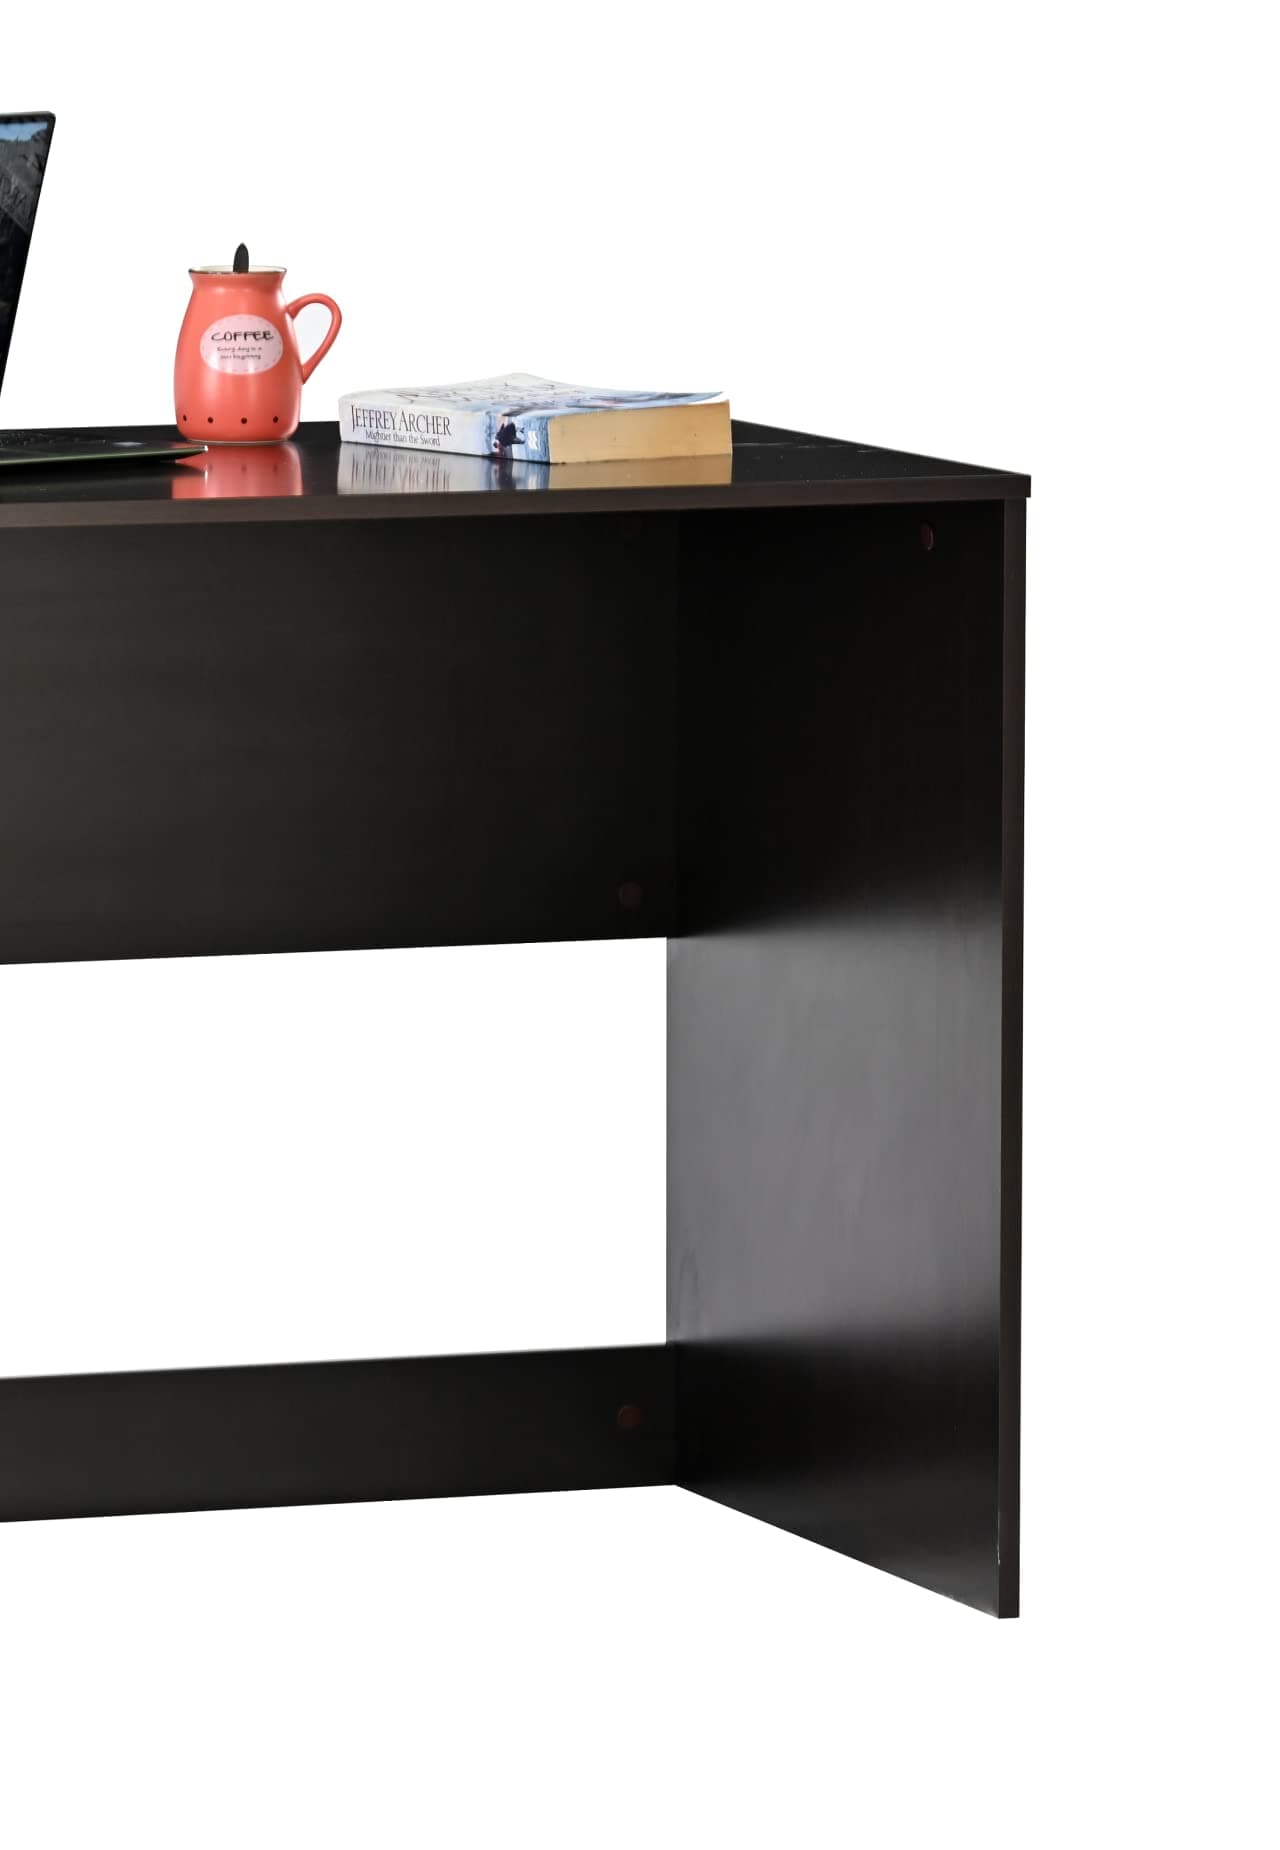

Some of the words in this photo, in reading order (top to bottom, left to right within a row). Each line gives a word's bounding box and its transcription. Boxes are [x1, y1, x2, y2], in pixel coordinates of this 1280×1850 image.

[211, 331, 274, 341] COFFEE
[351, 405, 397, 432] JEFFREY
[399, 410, 452, 436] ARCHER
[365, 429, 391, 443] Mightier
[393, 431, 407, 442] than
[408, 433, 419, 442] the
[420, 434, 441, 446] Sword
